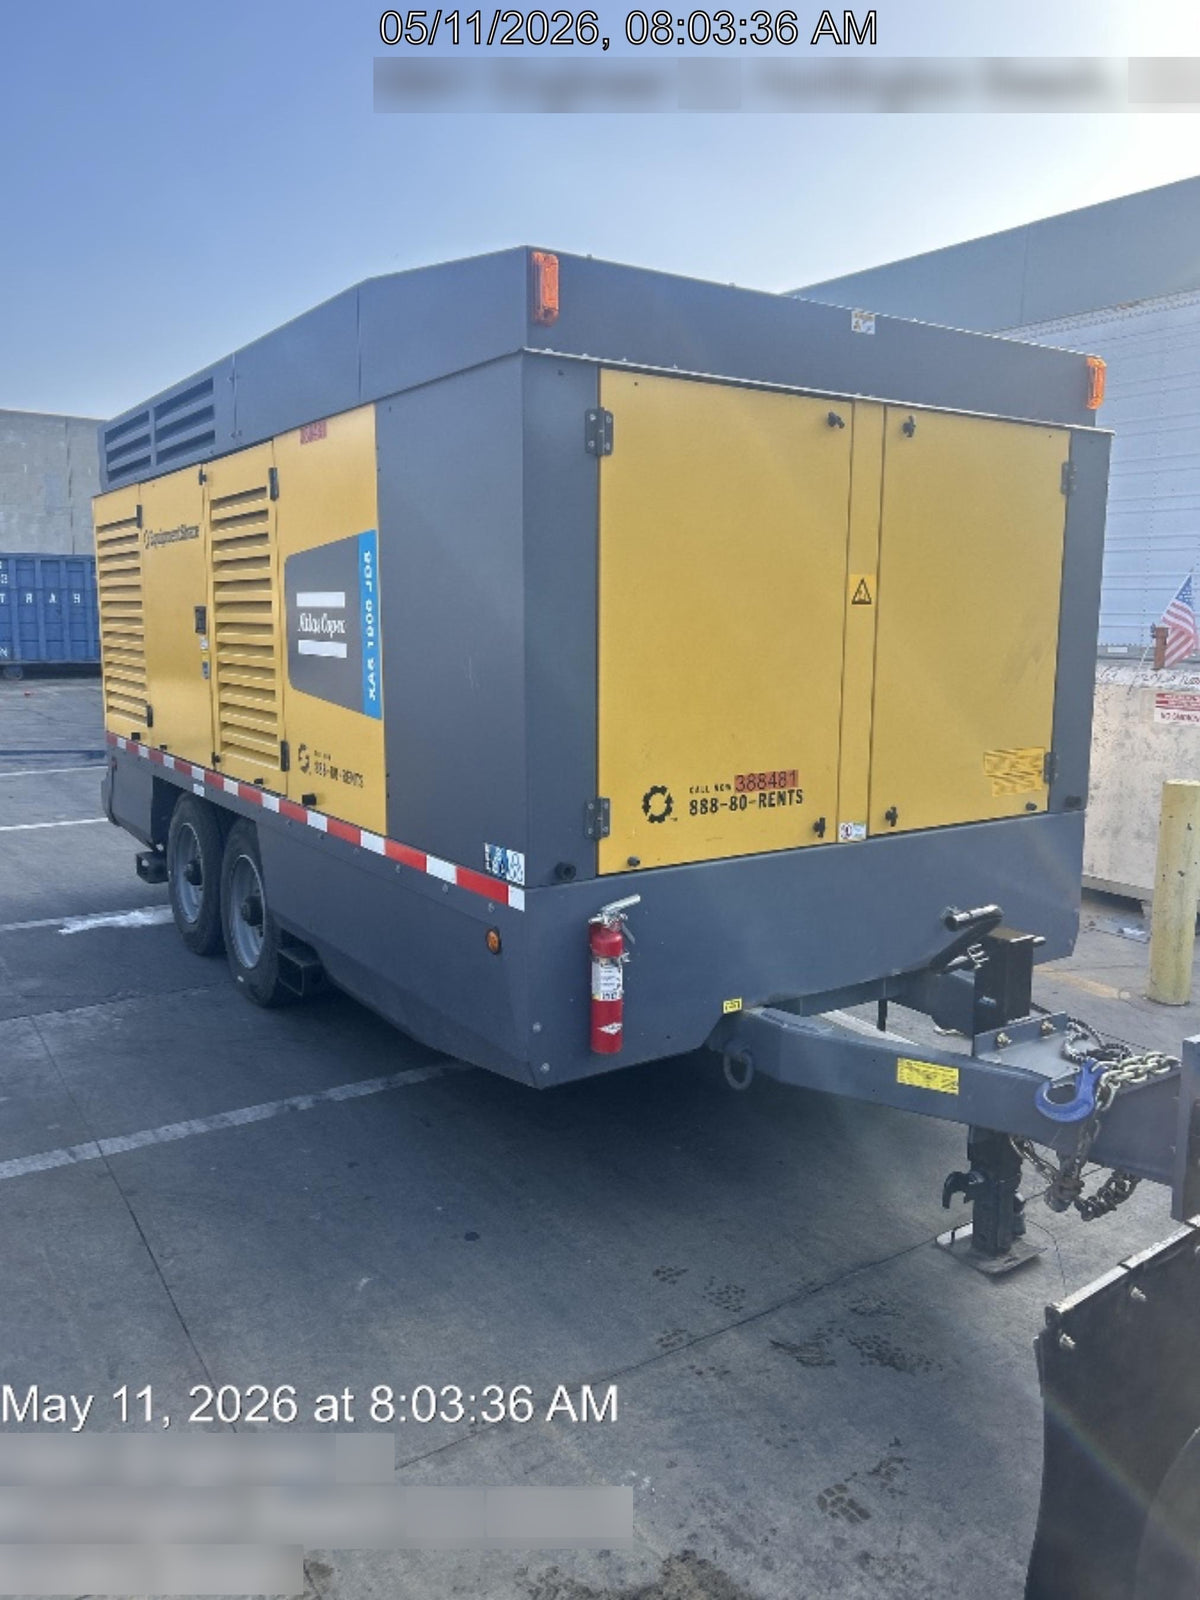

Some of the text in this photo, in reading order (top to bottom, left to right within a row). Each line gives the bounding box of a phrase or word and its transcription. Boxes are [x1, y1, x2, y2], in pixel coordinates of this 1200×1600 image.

[689, 784, 710, 794] CALL
[735, 770, 798, 792] 388481
[689, 789, 804, 816] 888-80-RENTS
